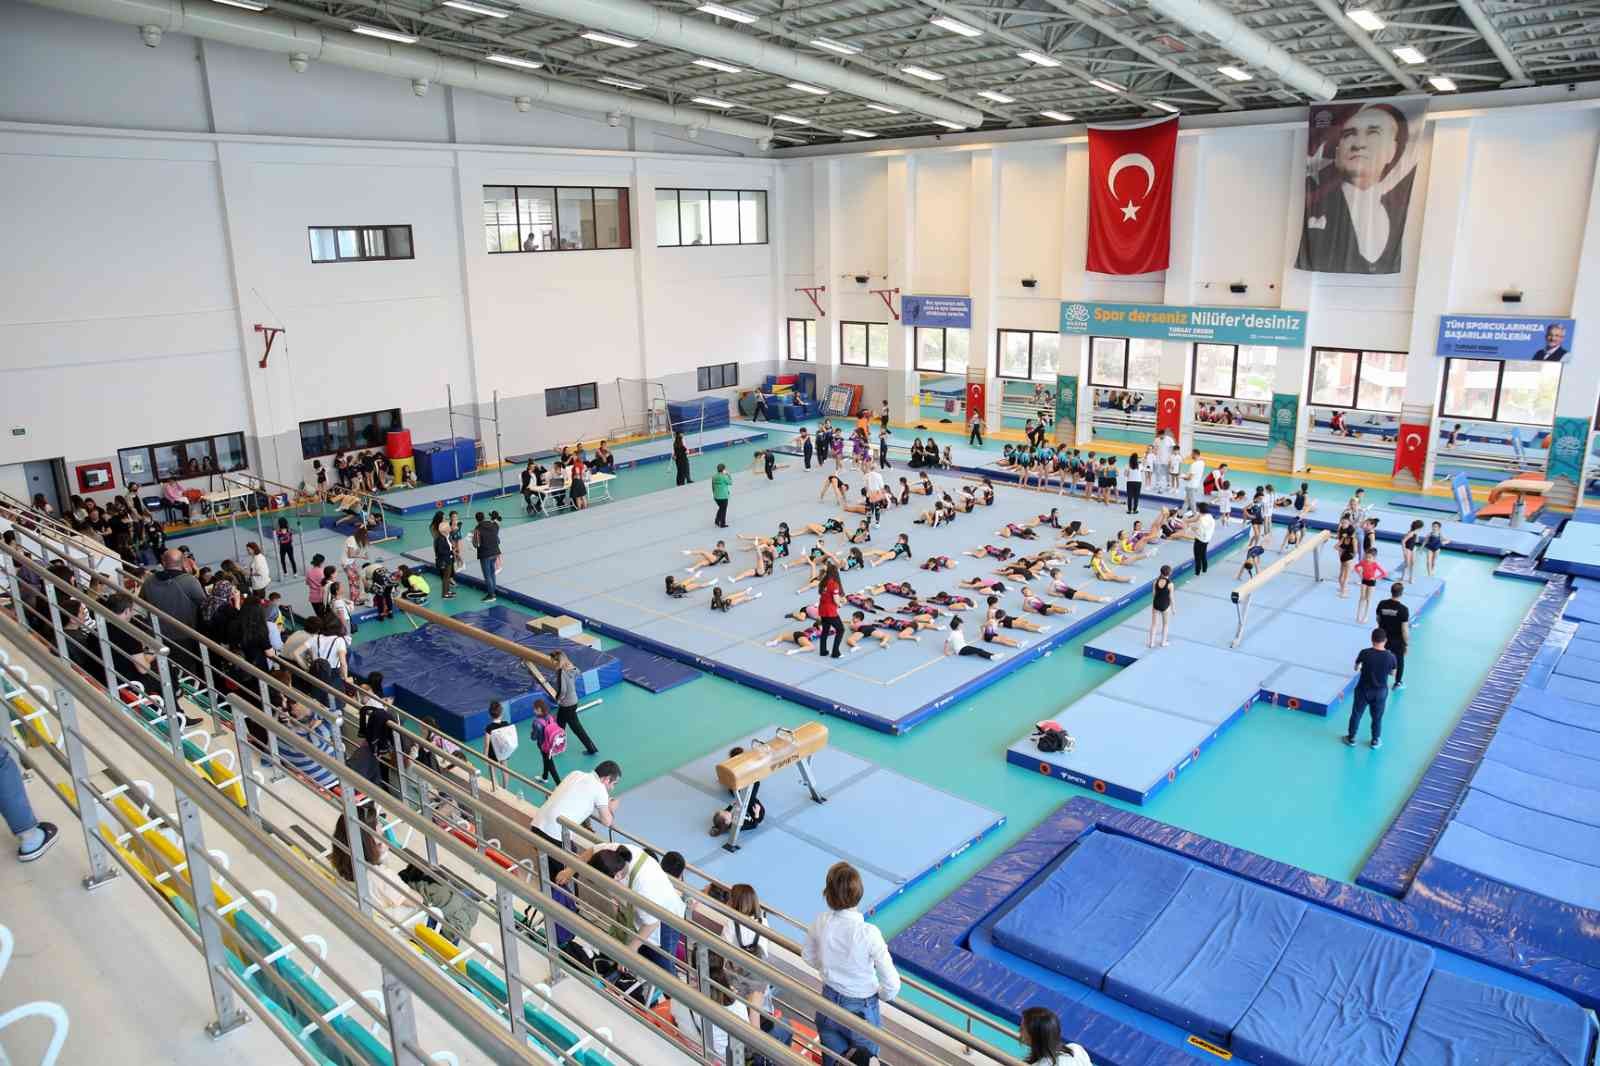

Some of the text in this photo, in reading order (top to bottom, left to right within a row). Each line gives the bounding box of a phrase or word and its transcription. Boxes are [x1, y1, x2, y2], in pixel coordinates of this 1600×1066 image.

[1094, 308, 1300, 330] Spor derseniz Nilüfer'desiniz
[1445, 319, 1465, 330] TÜM
